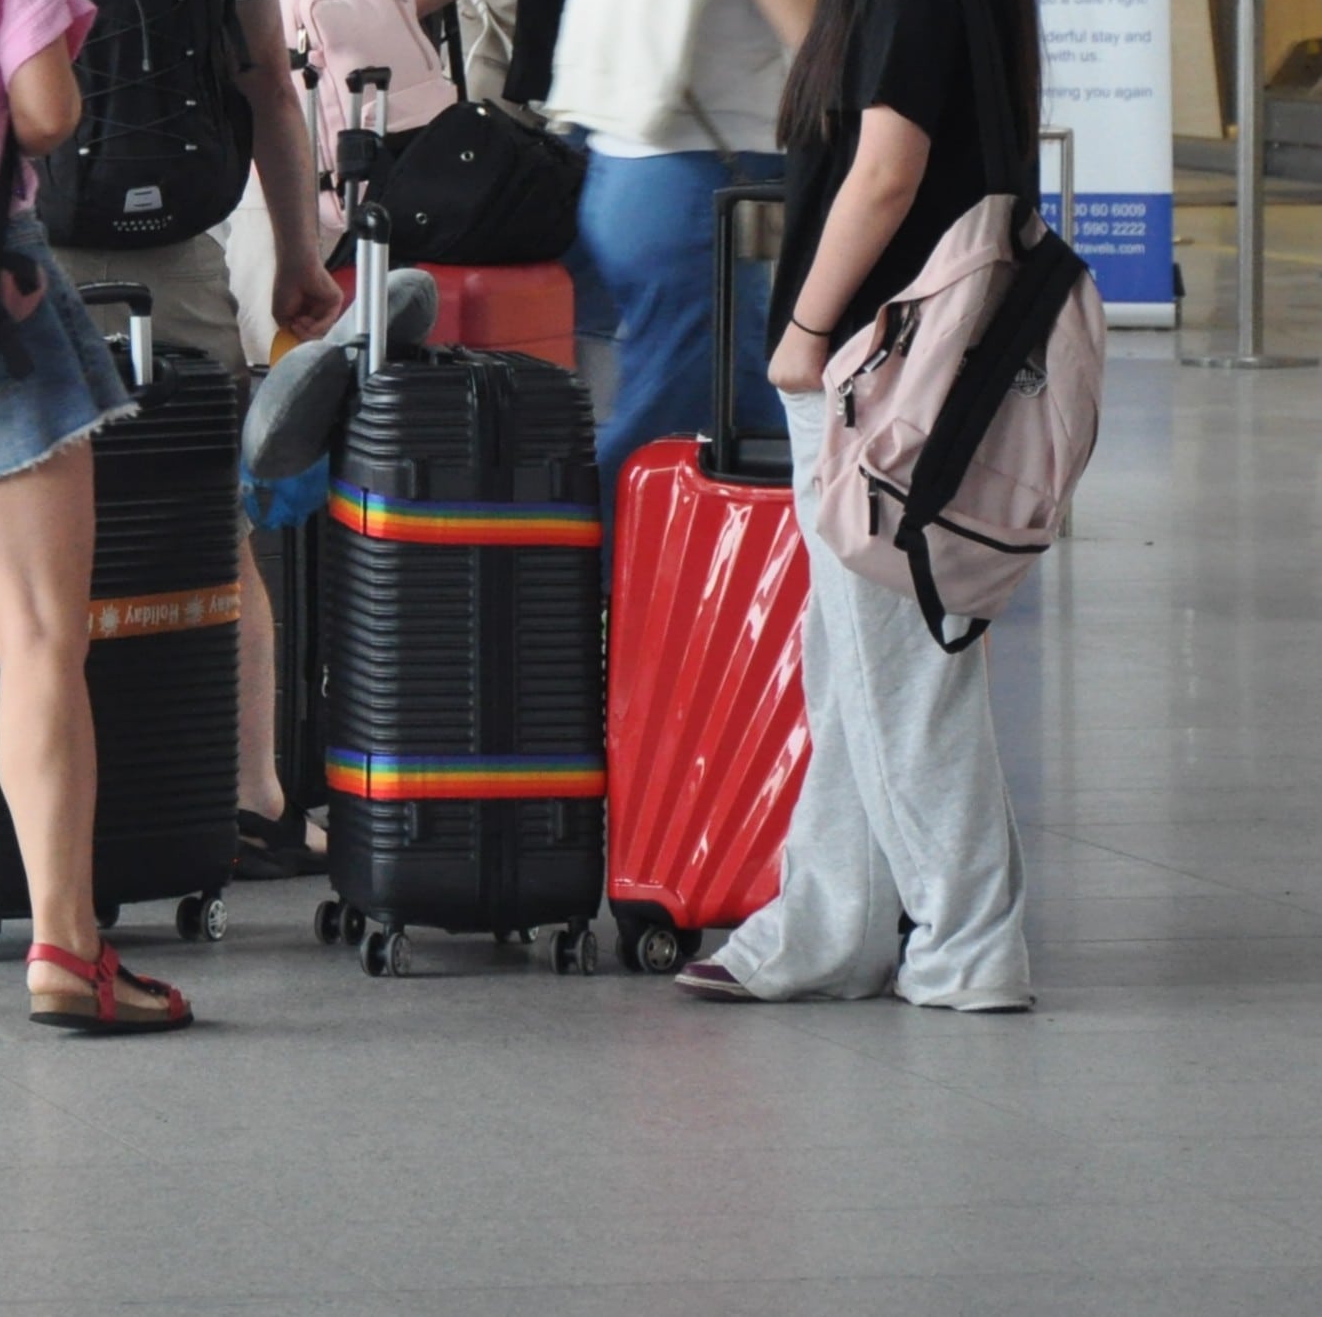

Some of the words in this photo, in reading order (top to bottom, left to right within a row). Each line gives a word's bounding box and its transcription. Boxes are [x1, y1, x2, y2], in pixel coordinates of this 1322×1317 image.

[1091, 31, 1119, 47] stay
[1124, 30, 1152, 43] and
[1085, 88, 1111, 101] you
[1115, 87, 1153, 102] again
[1090, 202, 1108, 217] 60
[1111, 202, 1146, 217] 6009
[1111, 221, 1146, 236] 2222
[1073, 241, 1145, 255] travels.com
[124, 602, 179, 628] Holiday
